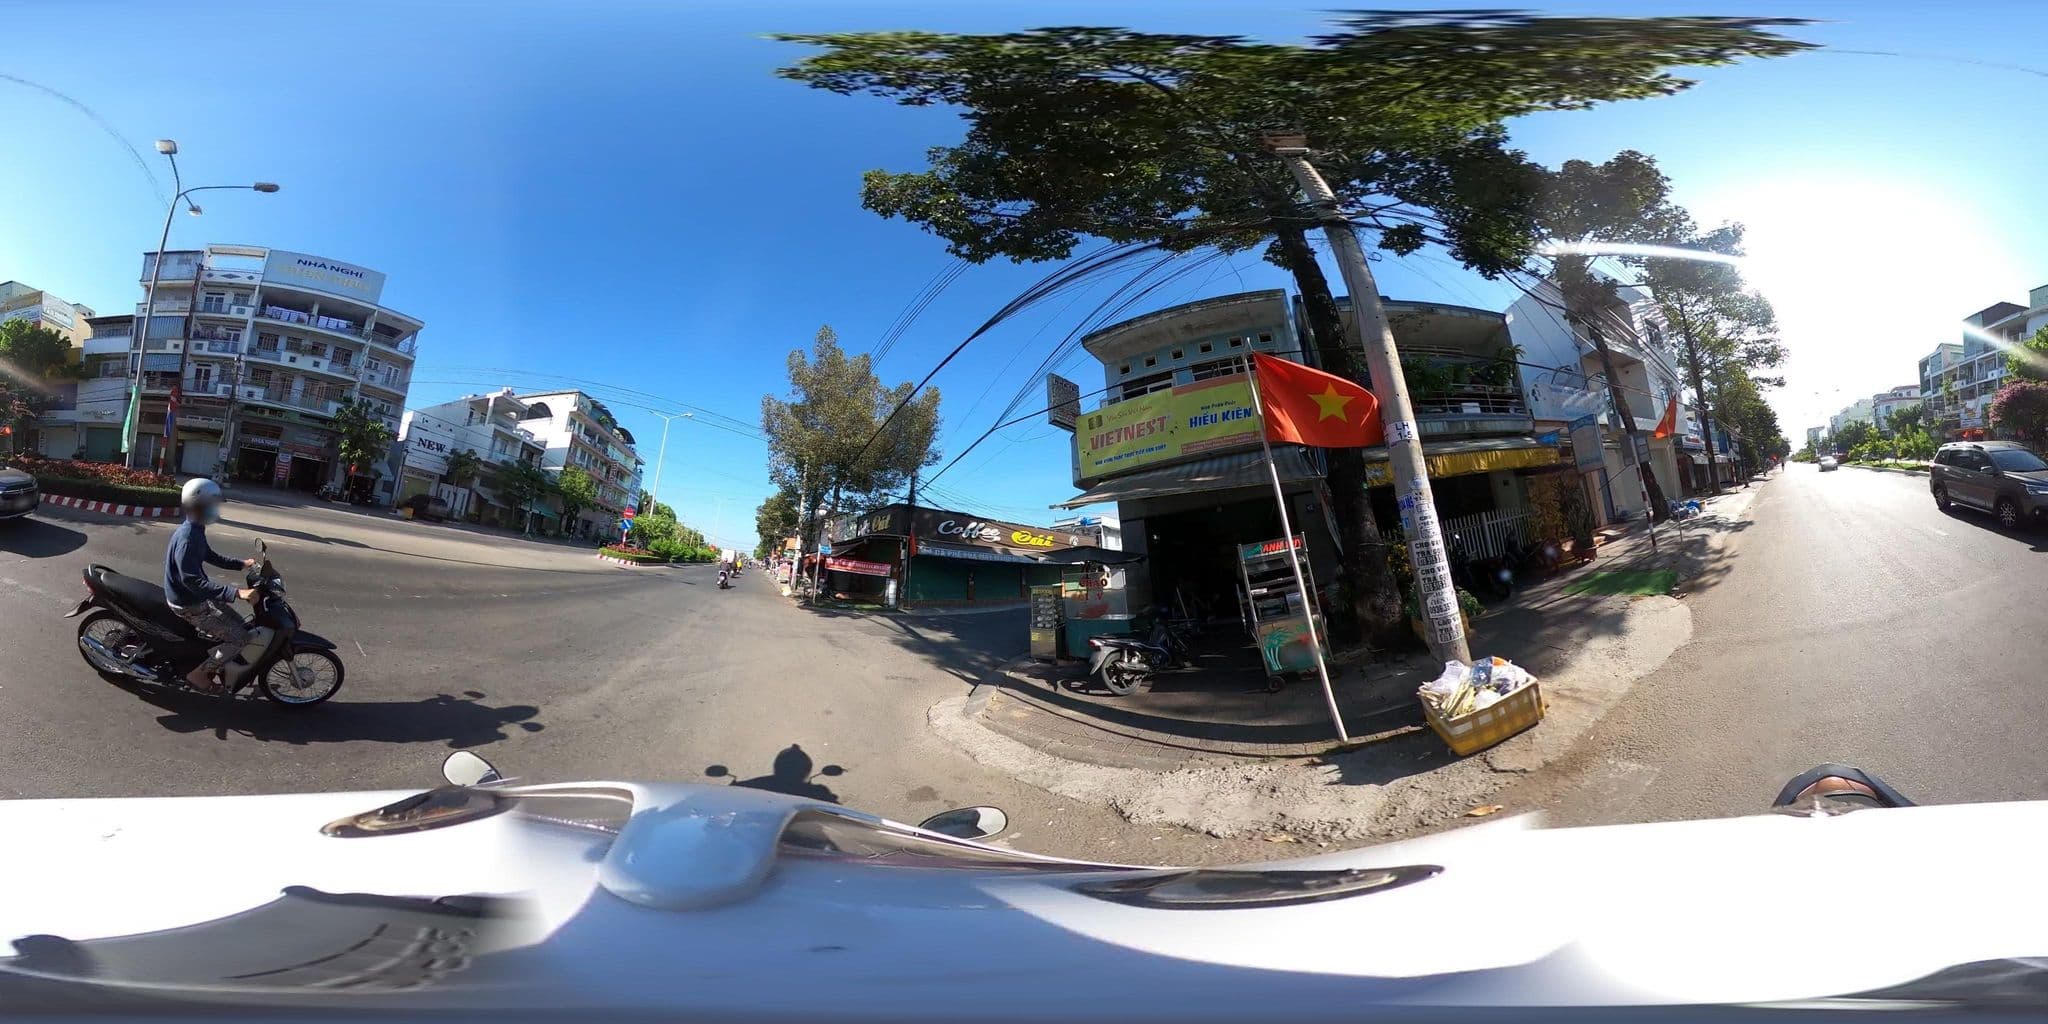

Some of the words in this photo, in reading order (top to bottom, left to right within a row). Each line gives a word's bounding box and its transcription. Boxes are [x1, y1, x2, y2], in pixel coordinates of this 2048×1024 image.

[297, 258, 328, 270] NHÀ
[1189, 411, 1218, 428] HIẾU
[1222, 406, 1252, 422] KIÊN
[1090, 416, 1167, 450] VIETNEST
[1395, 421, 1409, 431] LH
[417, 437, 447, 453] NEW
[938, 520, 1001, 543] Coffee
[1414, 541, 1430, 549] CHO
[1420, 567, 1435, 575] CHO
